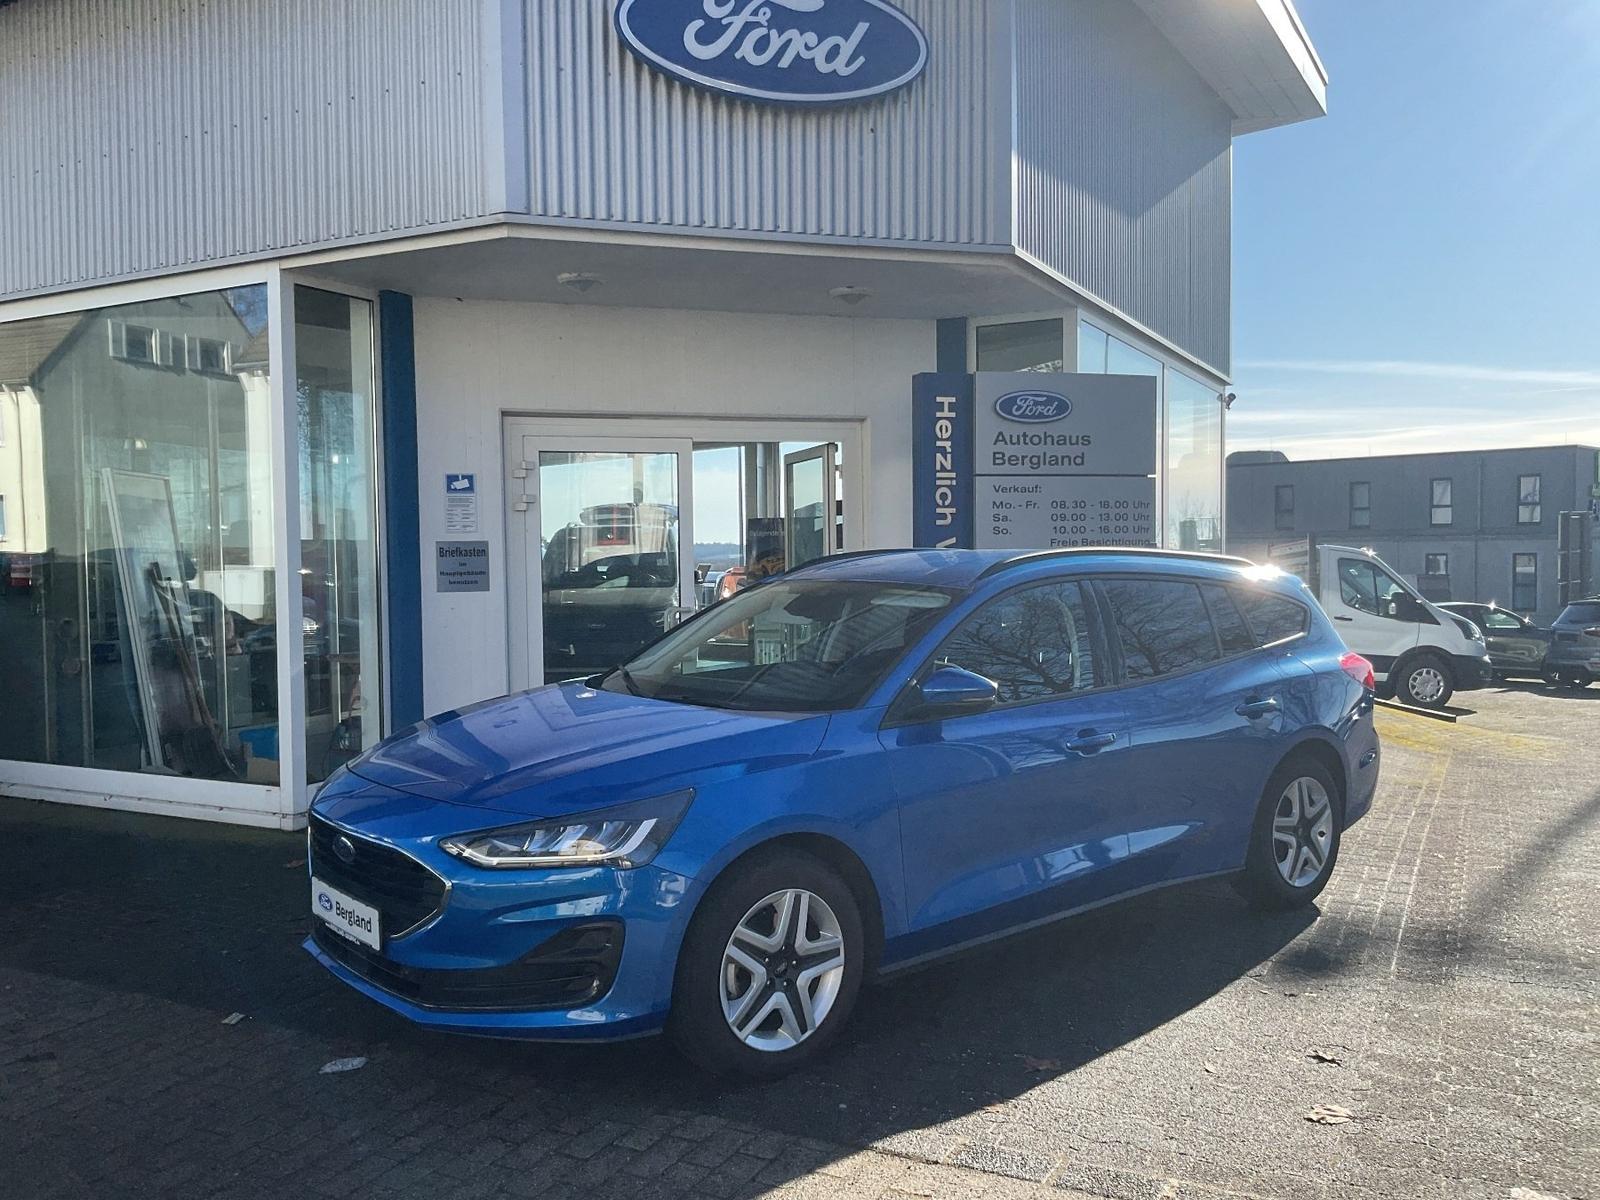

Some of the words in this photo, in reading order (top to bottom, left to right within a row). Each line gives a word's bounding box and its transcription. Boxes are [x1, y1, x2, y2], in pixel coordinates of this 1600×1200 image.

[683, 0, 871, 77] Ford
[1012, 395, 1058, 416] Ford
[993, 431, 1092, 446] Autohaus
[935, 396, 957, 525] Herzlich
[992, 451, 1085, 470] Bergland
[992, 484, 1042, 494] Verkauf:
[1050, 500, 1087, 510] 08.30
[1132, 500, 1151, 510] Uhr
[992, 513, 1012, 523] Sa.
[1050, 513, 1087, 522] 09.00
[1098, 513, 1129, 522] 13.00
[1132, 513, 1150, 522] Uhr
[992, 526, 1012, 535] So.
[1053, 525, 1087, 535] 10.00
[1132, 525, 1150, 535] Uhr
[439, 546, 486, 558] Briefkasten
[335, 900, 372, 933] Bergland
